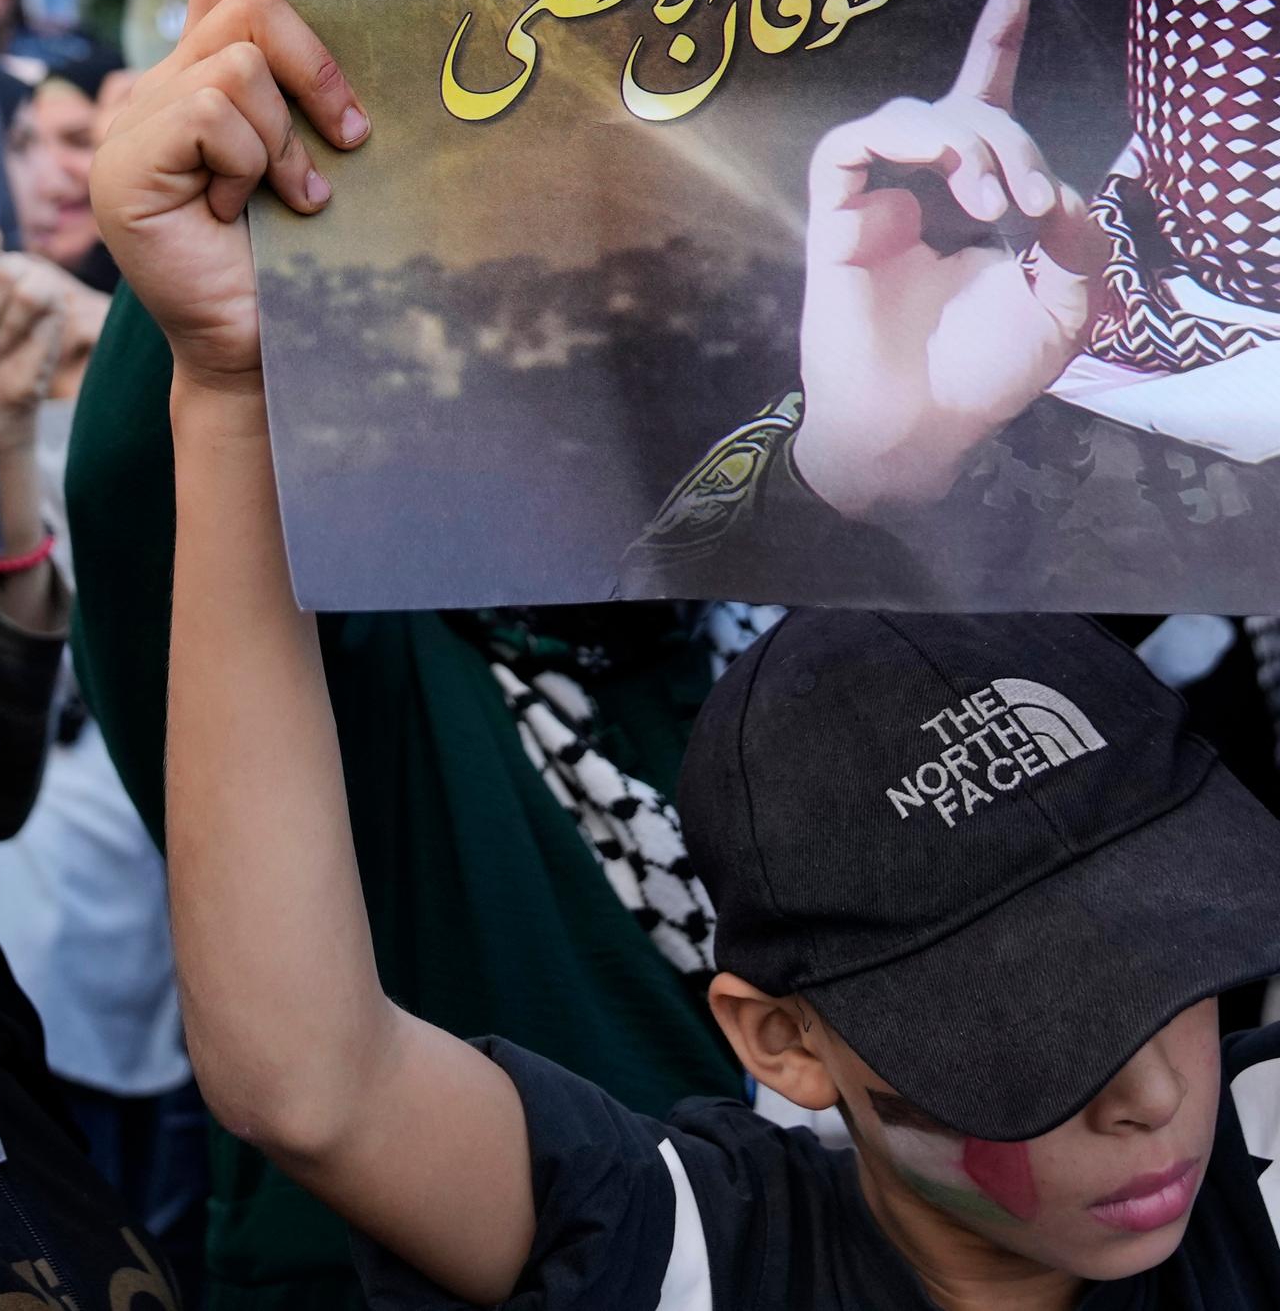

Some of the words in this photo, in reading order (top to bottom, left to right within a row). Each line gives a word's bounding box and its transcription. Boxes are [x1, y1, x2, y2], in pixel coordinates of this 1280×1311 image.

[920, 686, 1010, 747] THE
[885, 711, 1031, 821] NORTH
[933, 747, 1051, 828] FACE
